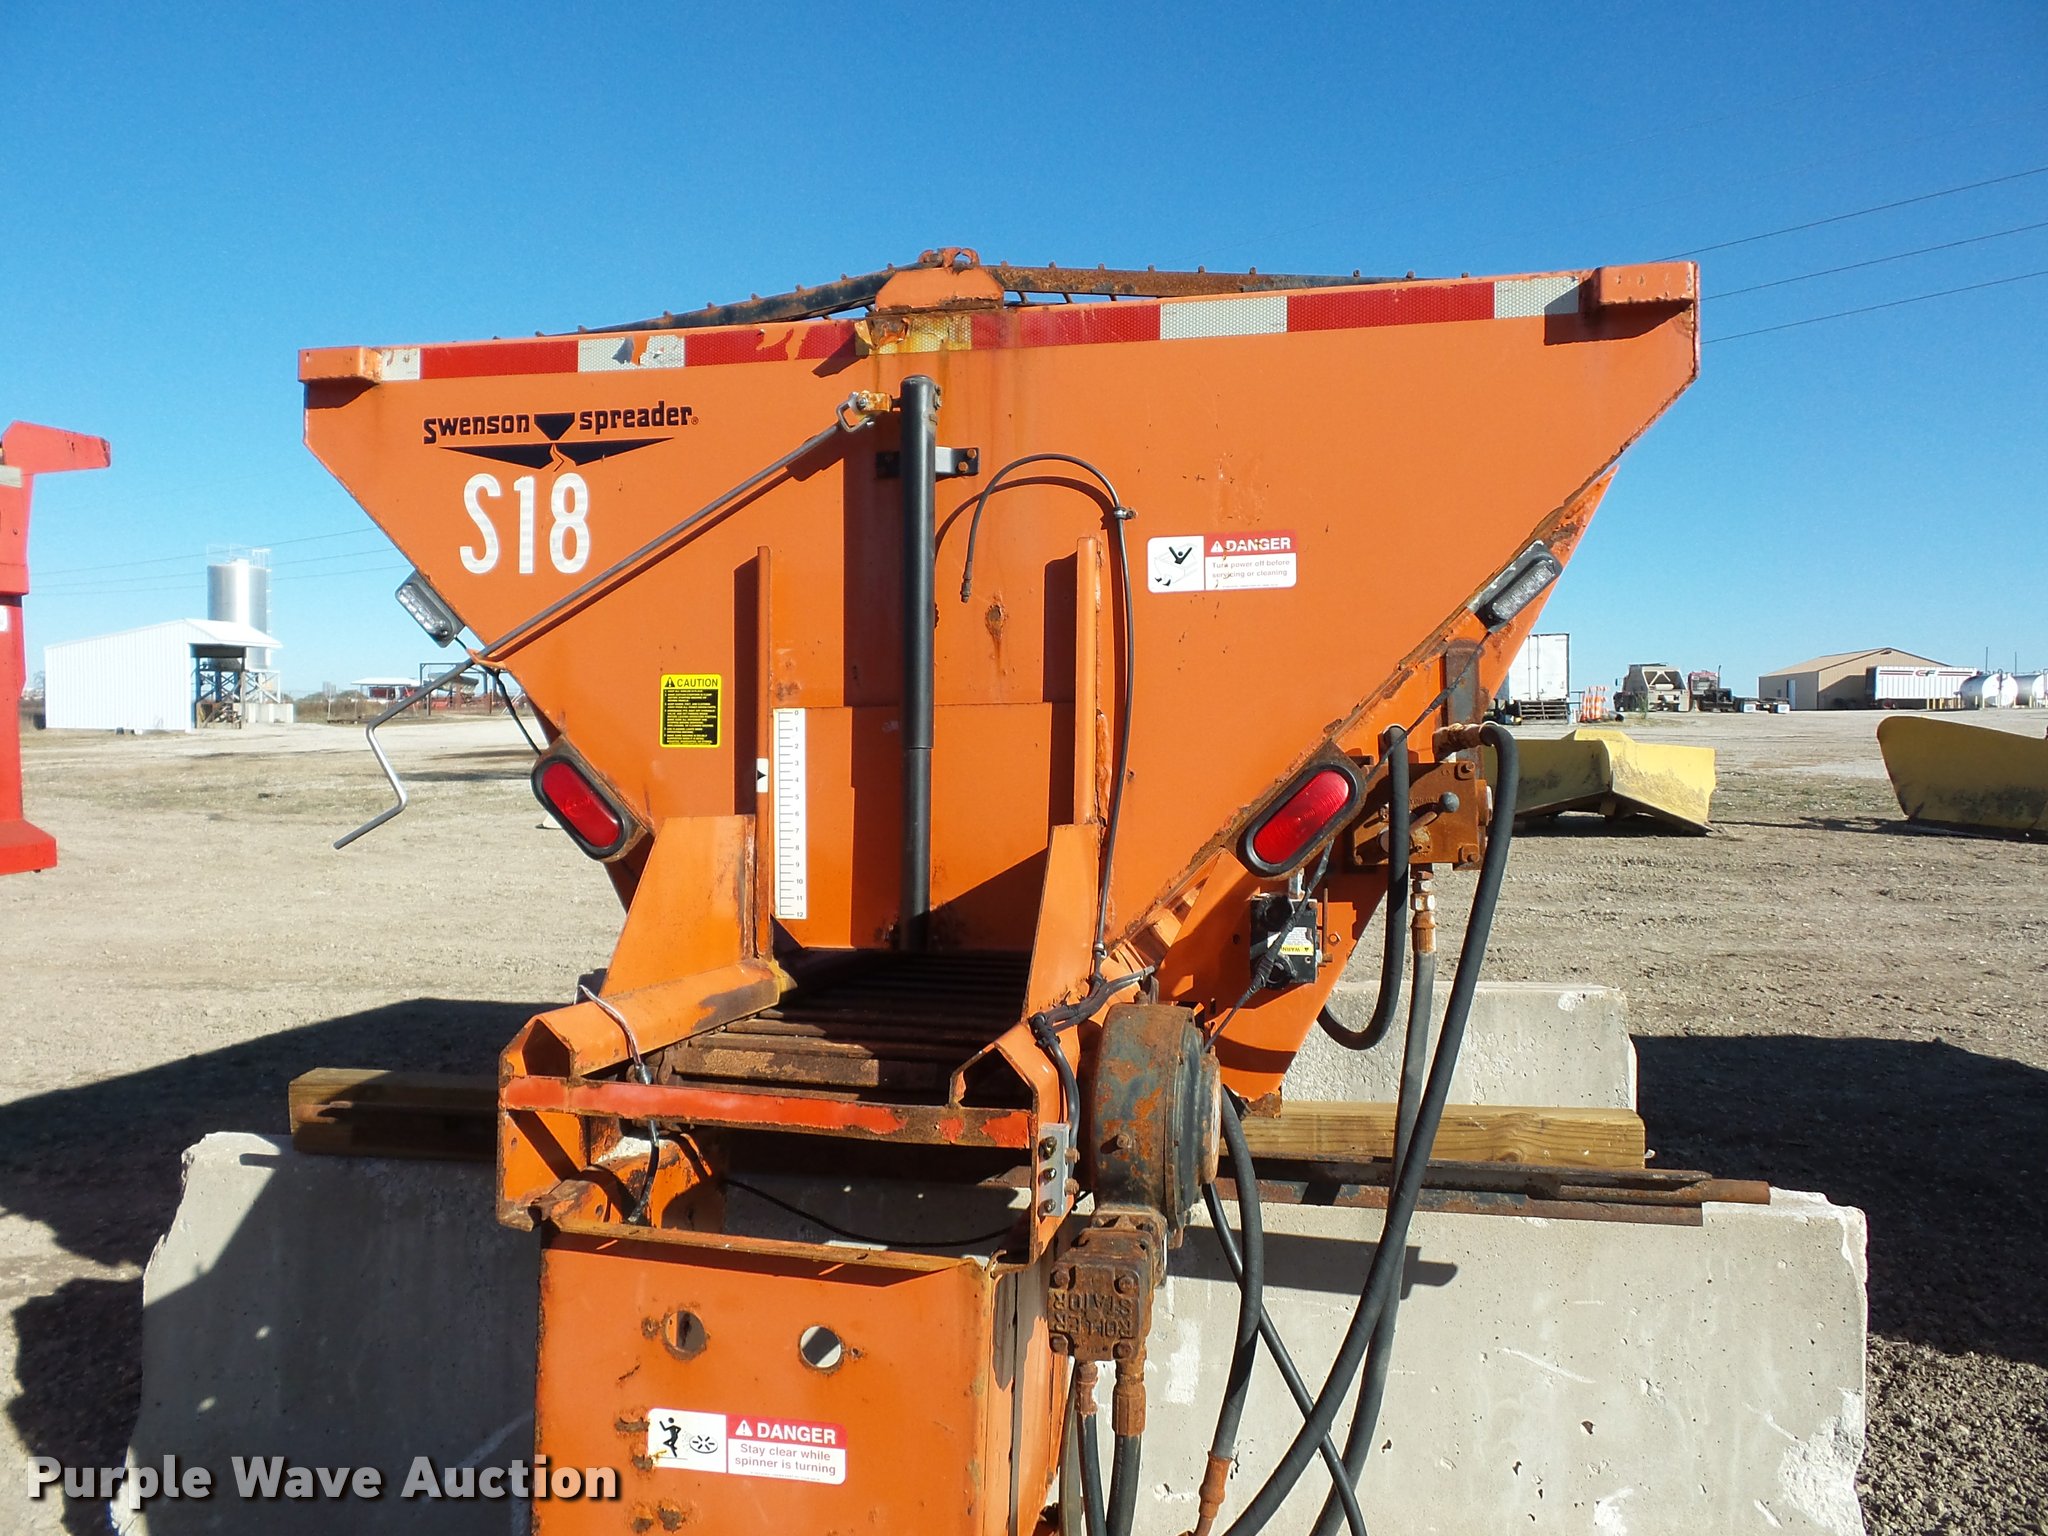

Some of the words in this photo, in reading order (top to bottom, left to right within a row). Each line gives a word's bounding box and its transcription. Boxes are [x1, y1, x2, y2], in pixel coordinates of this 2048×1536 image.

[423, 413, 530, 444] Swenson
[459, 471, 591, 575] S18
[1225, 536, 1291, 552] DANGER
[1230, 560, 1252, 569] power
[1254, 559, 1265, 567] off
[1266, 558, 1290, 567] before
[1212, 570, 1245, 579] servicing
[1256, 568, 1288, 578] cleaning
[677, 678, 718, 688] CAUTION
[756, 1422, 836, 1445] DANGER
[740, 1443, 765, 1456] Stay
[768, 1446, 798, 1458] clear
[800, 1449, 831, 1461] while
[735, 1457, 778, 1469] spinner
[781, 1460, 792, 1470] is
[794, 1461, 836, 1476] turning
